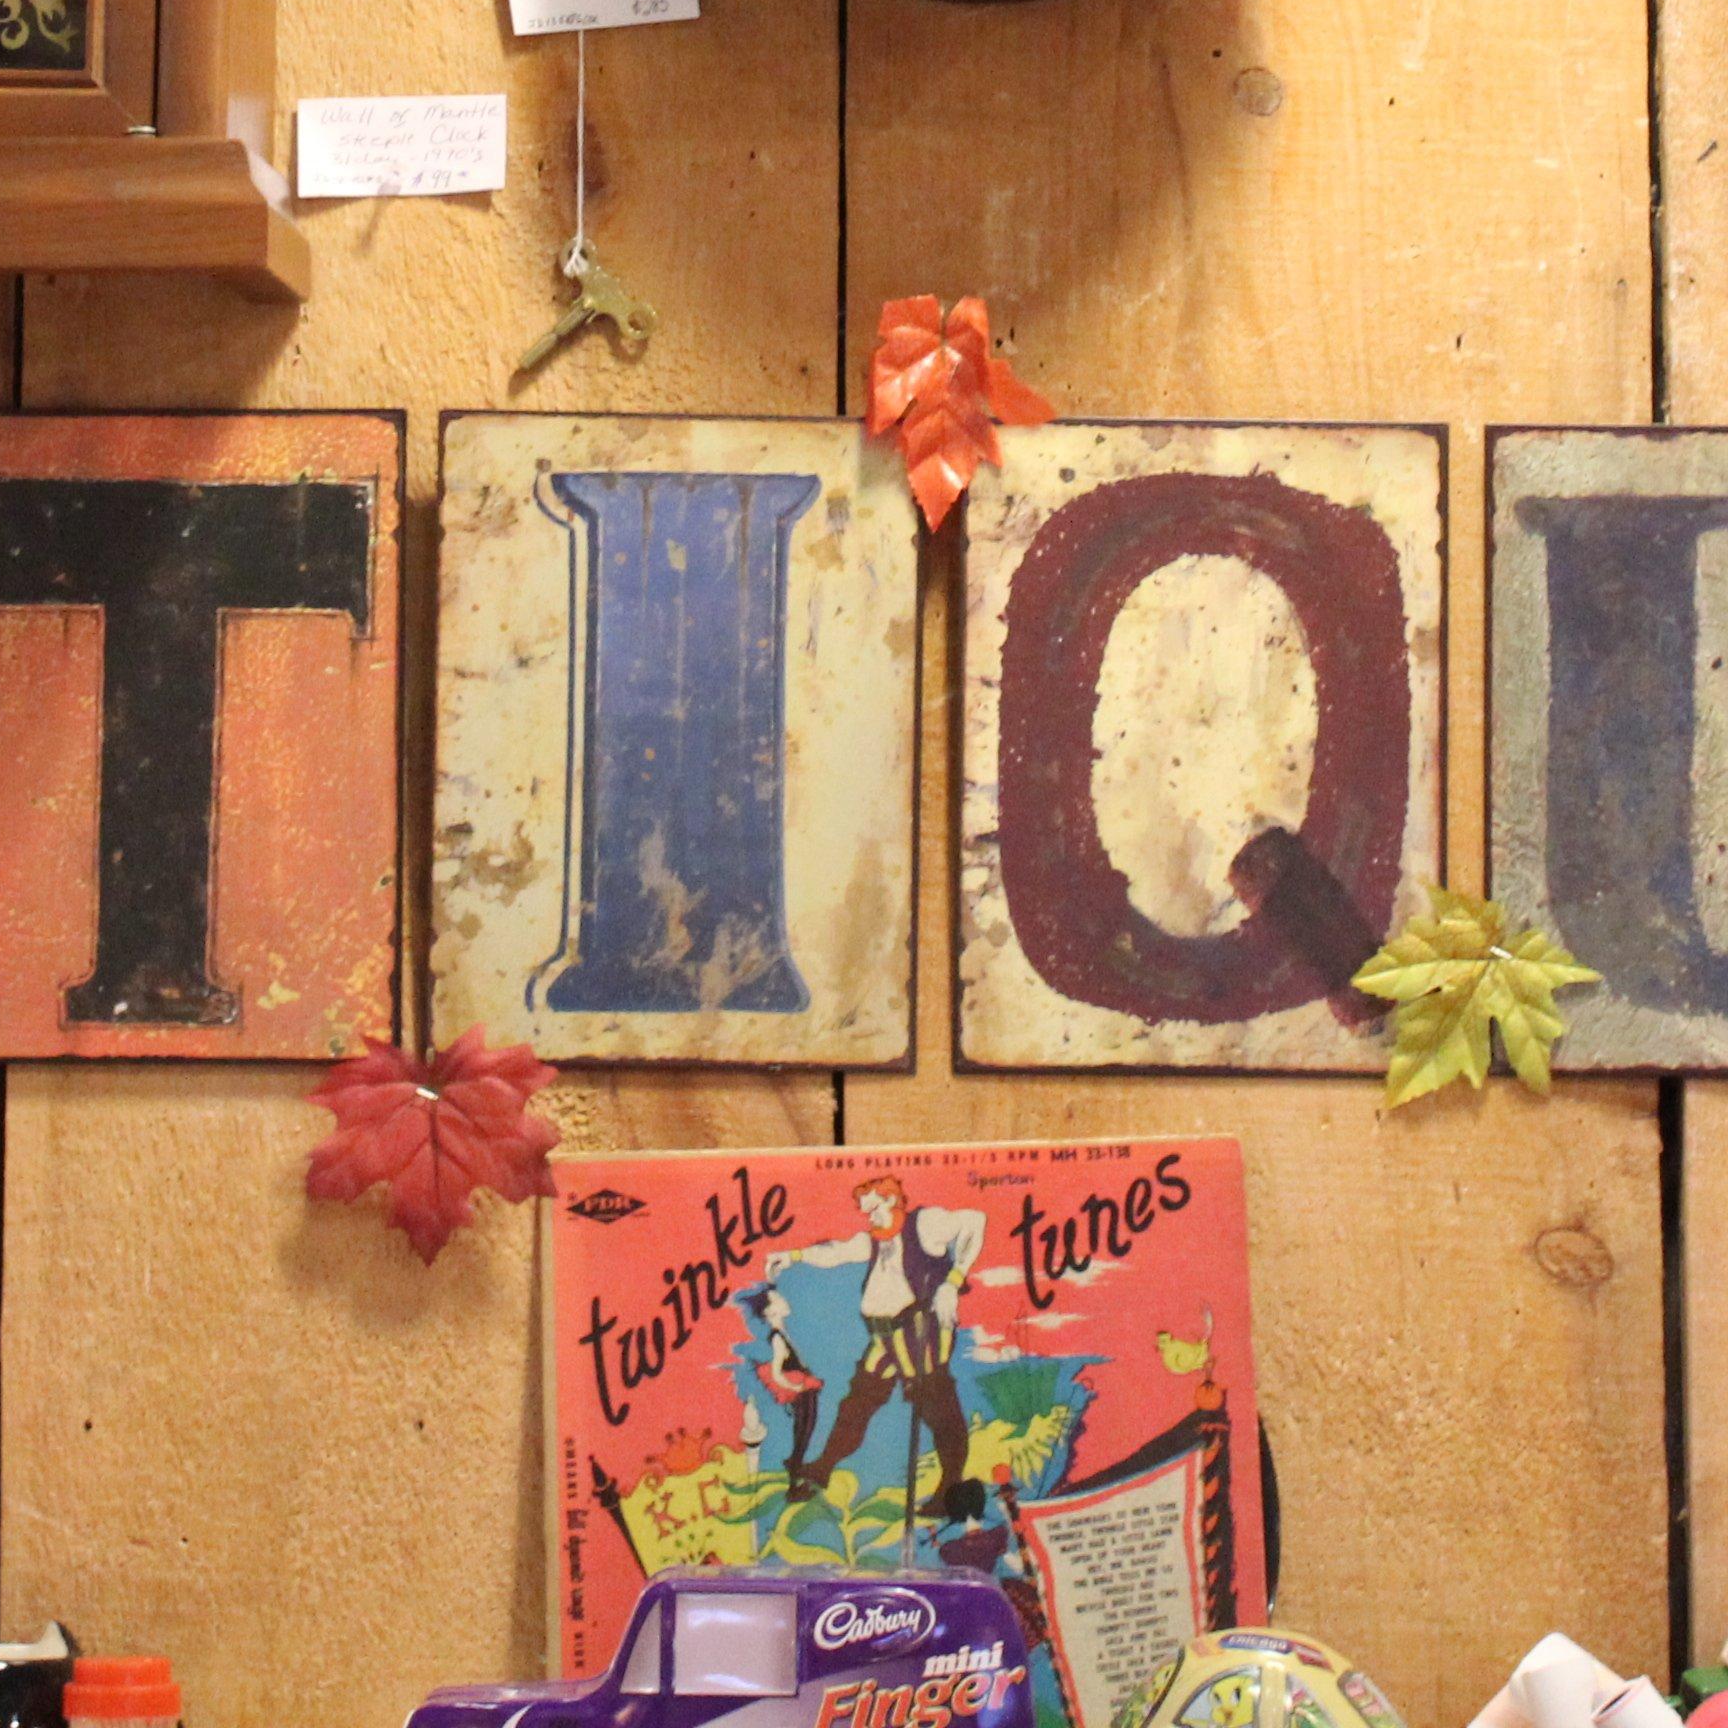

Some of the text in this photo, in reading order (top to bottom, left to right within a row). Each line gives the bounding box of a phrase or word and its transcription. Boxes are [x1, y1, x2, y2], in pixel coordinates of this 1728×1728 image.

[580, 1154, 1192, 1426] twinkle tunes
[813, 1602, 922, 1650] Cadbury
[923, 1641, 1004, 1677] mini
